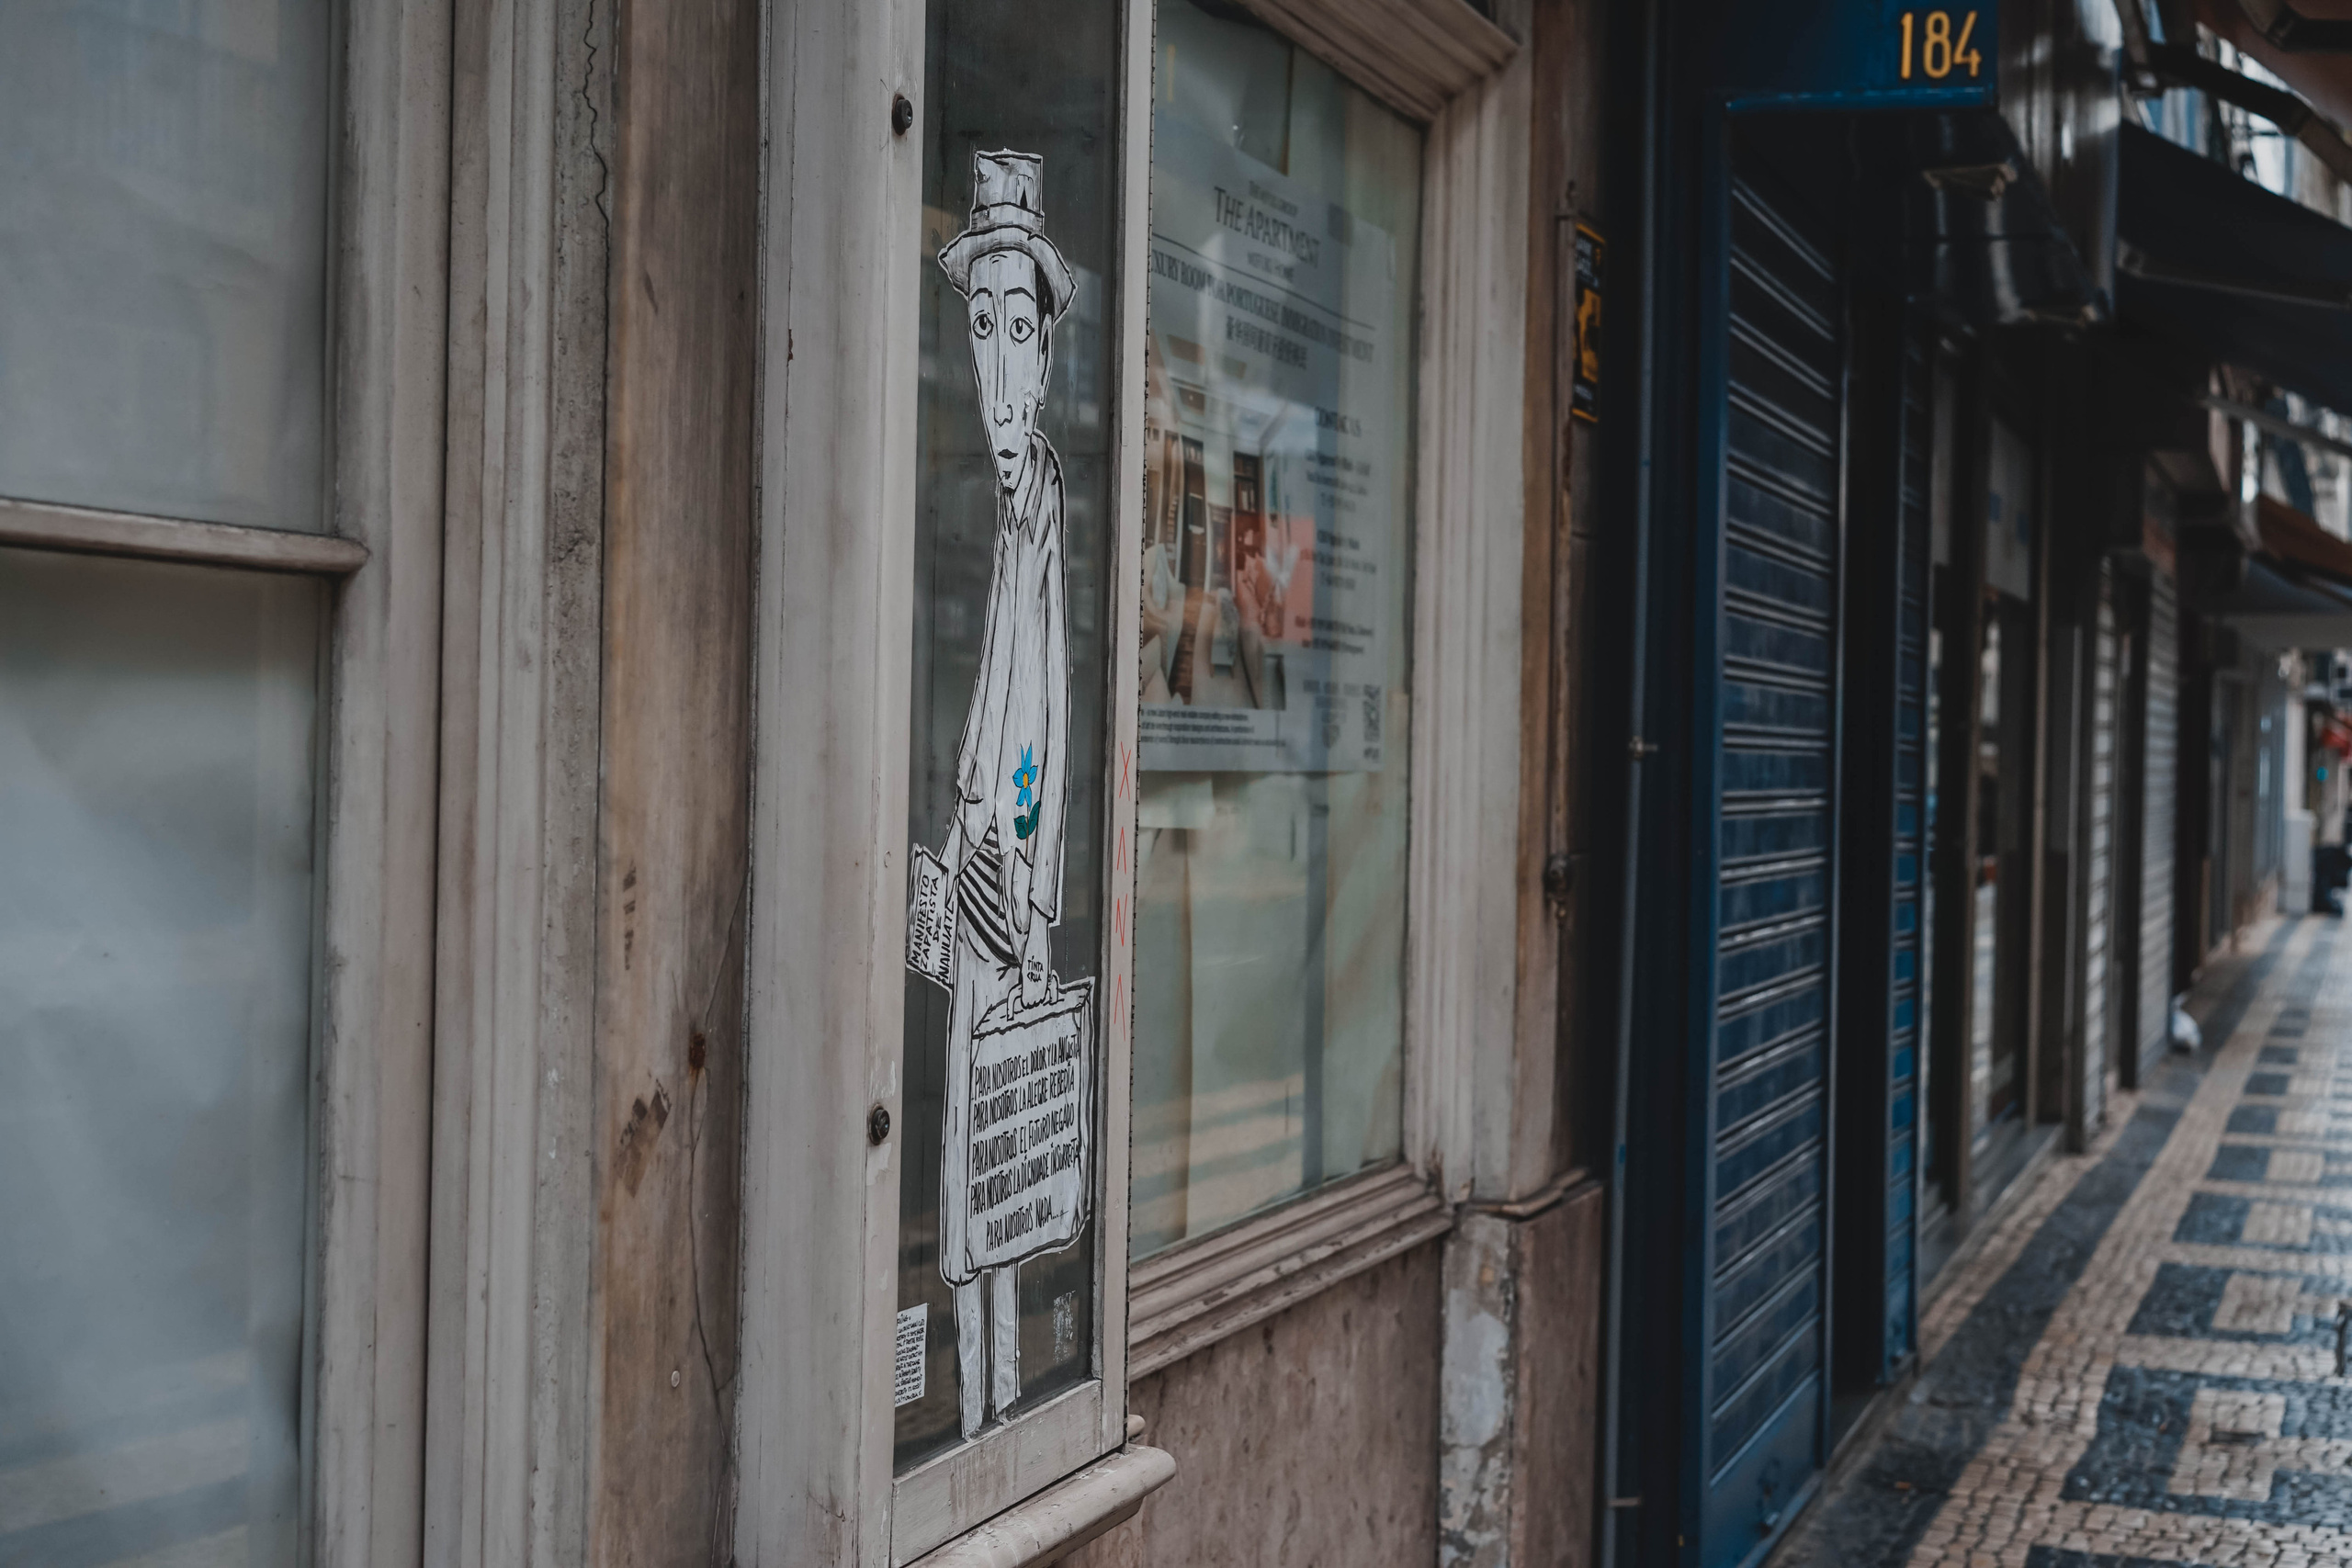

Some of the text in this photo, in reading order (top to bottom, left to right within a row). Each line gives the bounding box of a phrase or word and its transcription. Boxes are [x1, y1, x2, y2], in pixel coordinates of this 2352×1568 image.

[1901, 9, 1982, 80] 184
[1214, 186, 1244, 232] THE
[911, 874, 929, 964] MANIFESTO
[921, 876, 939, 970] ZAPATISTA
[938, 900, 955, 979] NAHUATL
[974, 1066, 991, 1100] PARA
[991, 1055, 1021, 1093] NOSOTROS
[1023, 1056, 1029, 1077] EL
[1031, 1045, 1047, 1075] DOLOR
[1047, 1043, 1051, 1066] Y
[1051, 1042, 1057, 1066] LA
[973, 1100, 989, 1135] PARA
[989, 1087, 1017, 1126] NOSOTROS
[1019, 1086, 1026, 1112] LA
[1027, 1077, 1048, 1110] ALEGRE
[972, 1102, 1075, 1180] PARA NOSOTROS EL FUTURO NEGADO
[970, 1182, 986, 1219] PARA
[986, 1169, 1012, 1210] NOSOTROS
[1013, 1165, 1020, 1194] LA
[987, 1219, 1003, 1252] PARA
[1004, 1202, 1034, 1247] NOSOTROS
